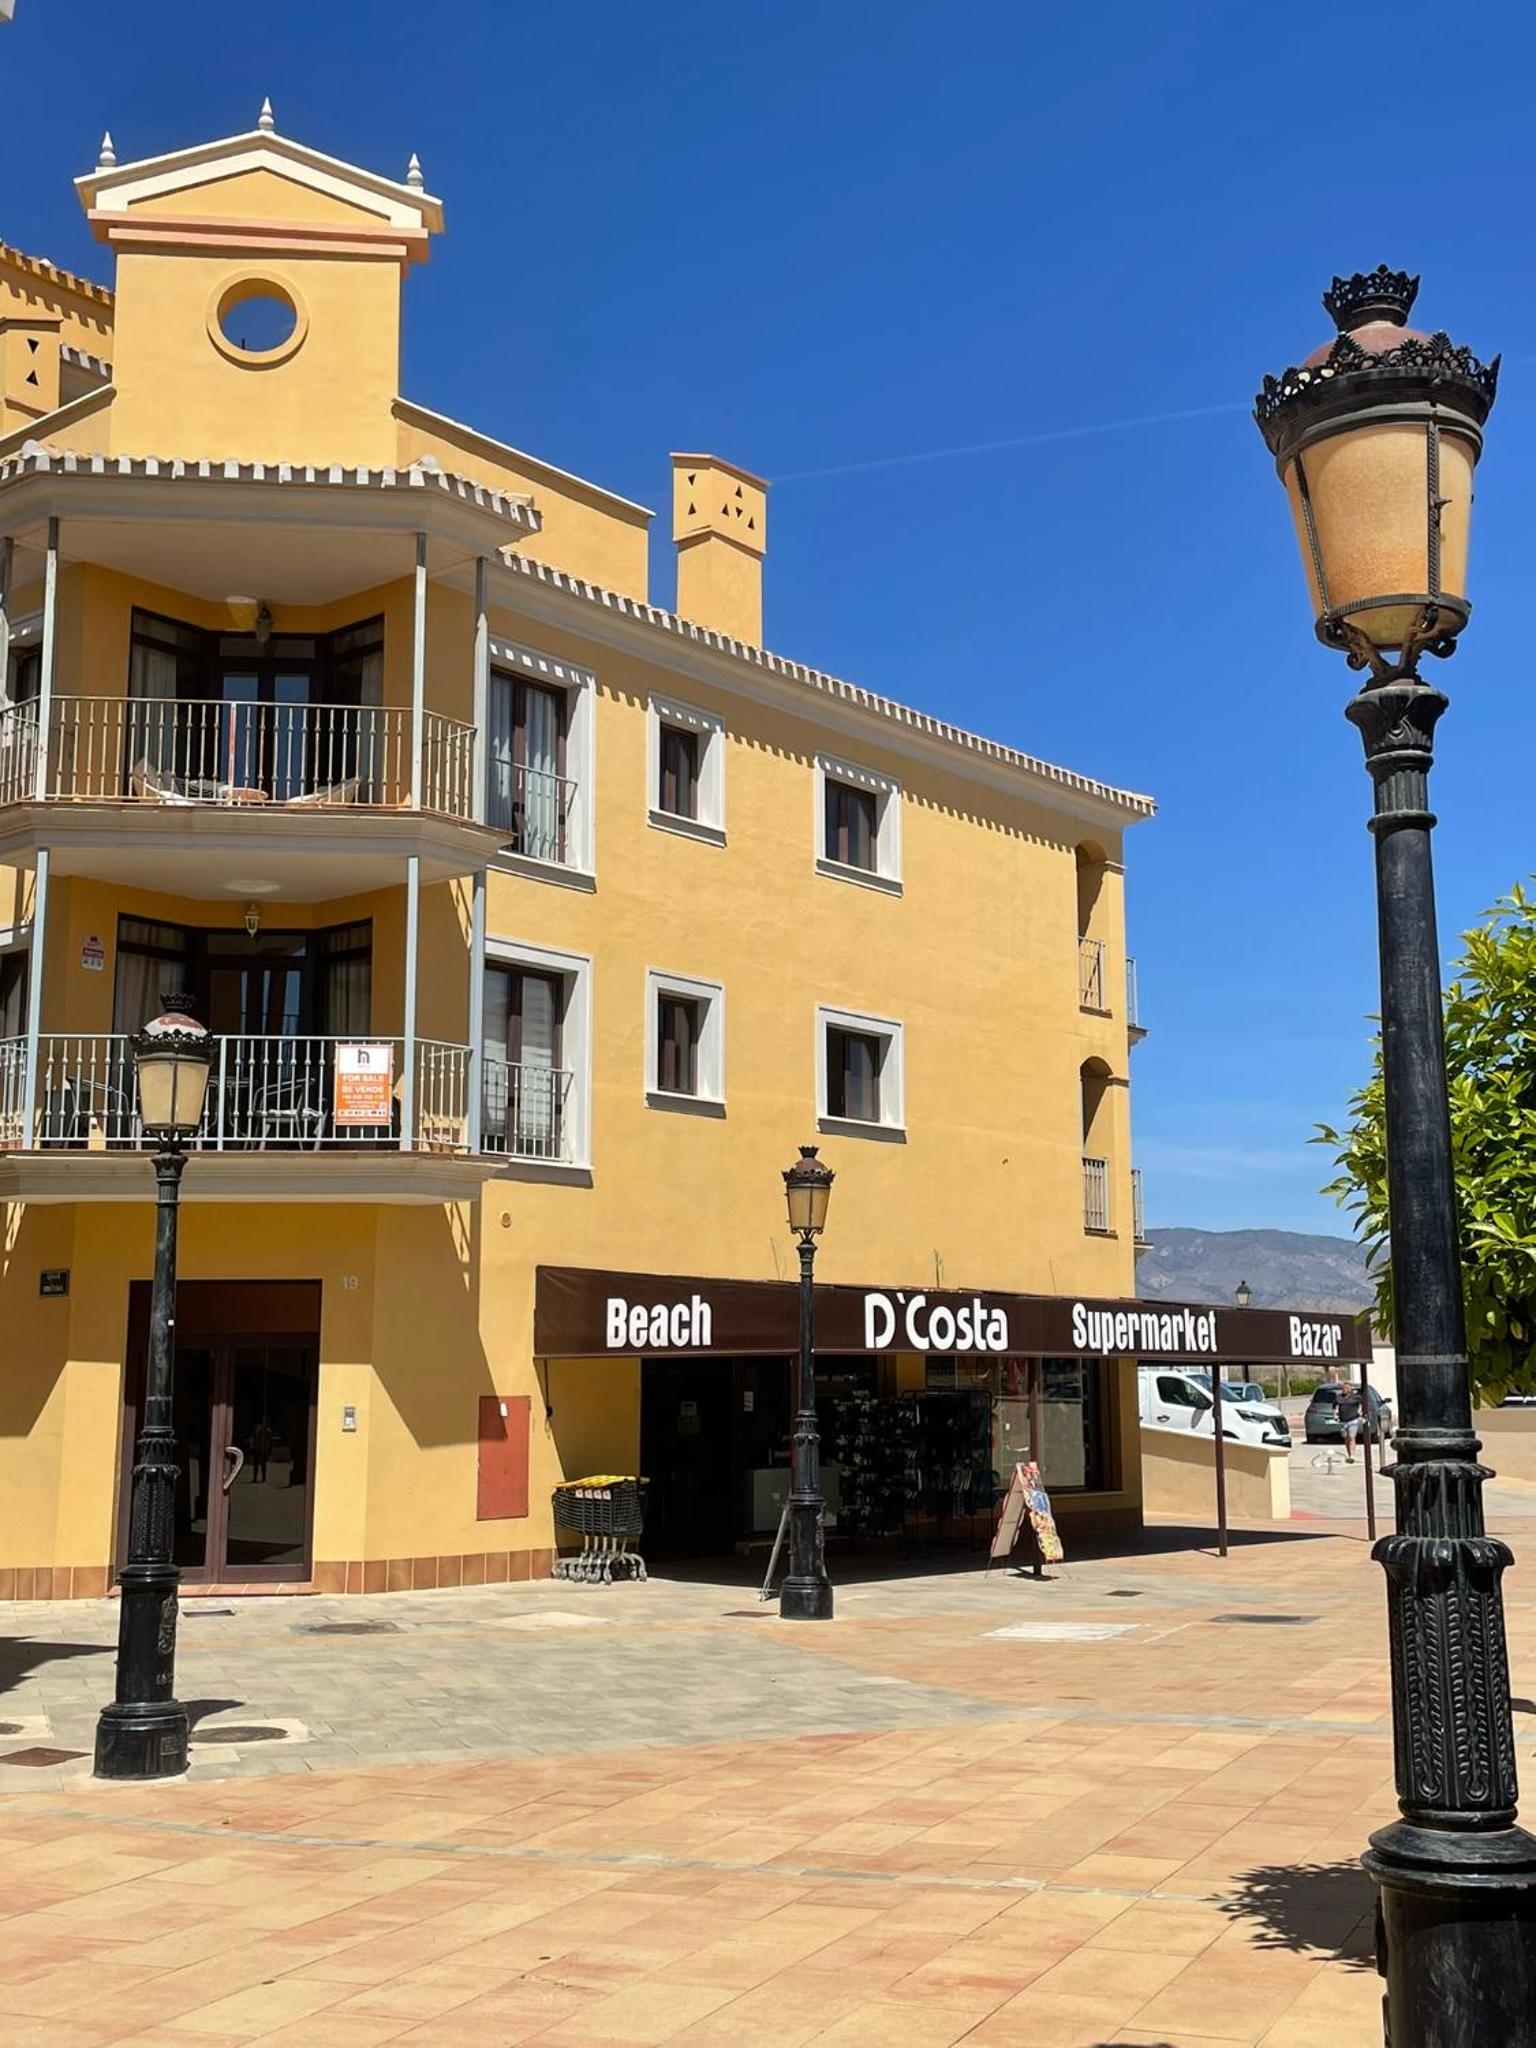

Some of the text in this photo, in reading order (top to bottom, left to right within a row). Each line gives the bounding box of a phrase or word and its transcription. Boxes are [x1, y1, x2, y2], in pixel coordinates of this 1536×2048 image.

[341, 1075, 384, 1083] FOR SALE
[354, 1086, 384, 1095] VENDE
[343, 1275, 359, 1290] 19
[606, 1295, 713, 1349] Beach
[1072, 1302, 1218, 1355] Supermarket
[1289, 1316, 1342, 1357] Bazar
